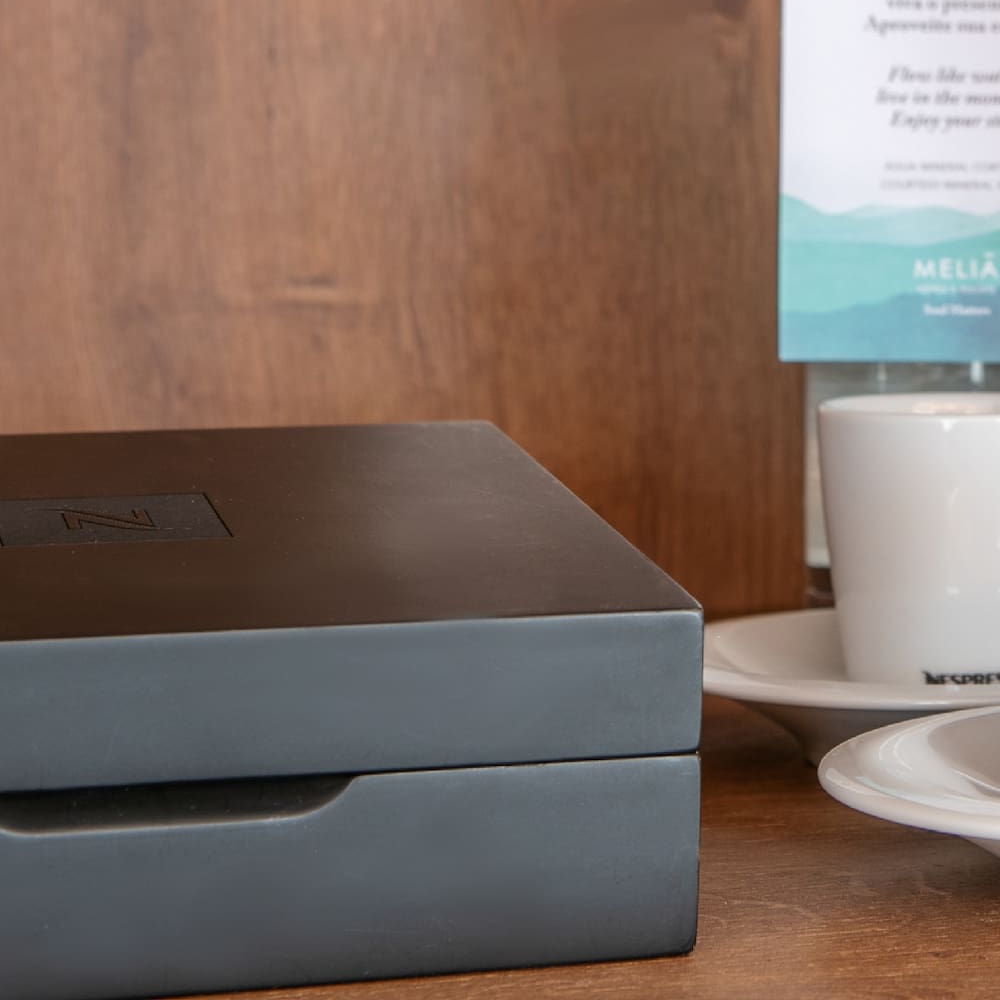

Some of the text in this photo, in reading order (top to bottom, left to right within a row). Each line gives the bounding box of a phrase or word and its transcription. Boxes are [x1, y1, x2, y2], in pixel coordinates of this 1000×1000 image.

[865, 14, 951, 36] Aproveite
[957, 23, 986, 34] sua
[888, 66, 931, 83] Flow
[936, 66, 965, 83] like
[875, 88, 908, 104] live
[912, 91, 930, 104] in
[934, 89, 960, 104] the
[890, 111, 940, 133] Enjoy
[943, 115, 981, 133] your
